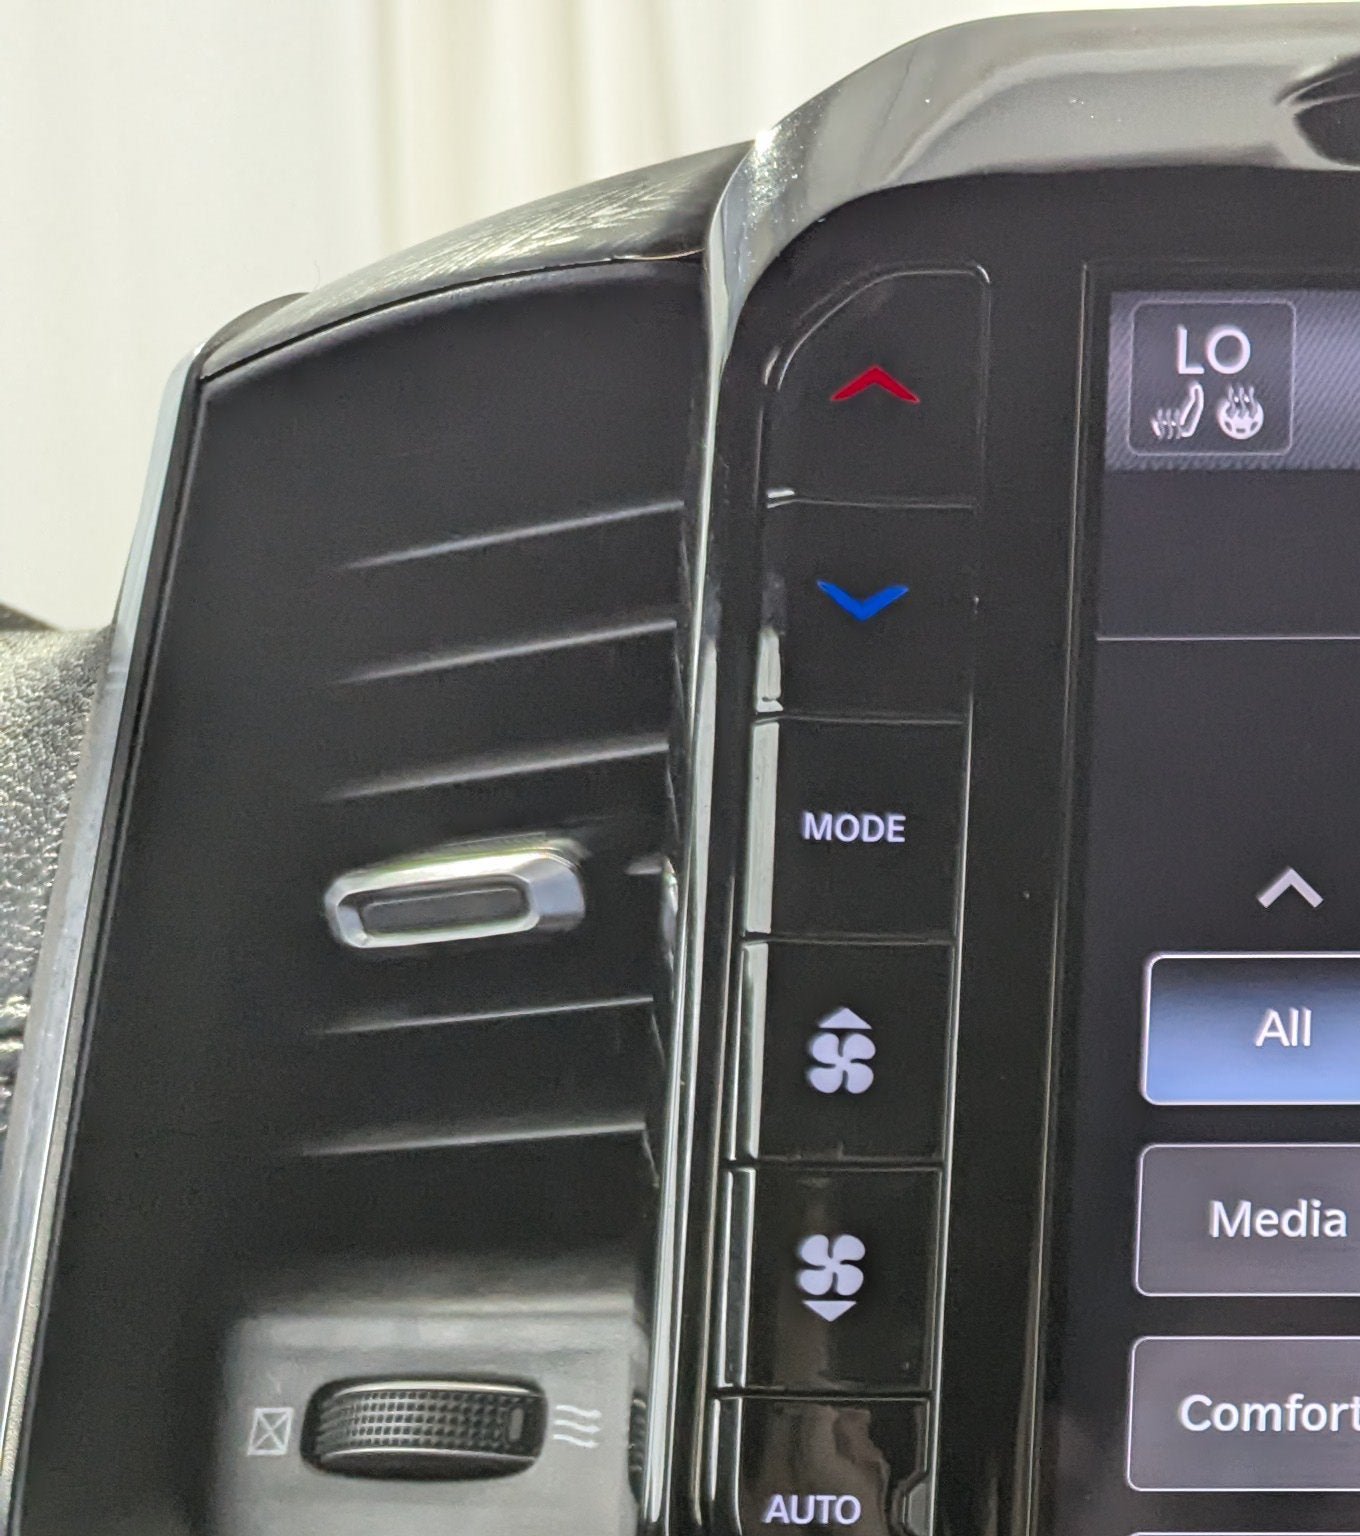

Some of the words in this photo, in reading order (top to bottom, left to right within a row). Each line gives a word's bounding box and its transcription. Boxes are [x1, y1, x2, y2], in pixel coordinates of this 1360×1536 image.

[1177, 326, 1251, 375] LO
[804, 812, 906, 843] MODE
[1255, 1008, 1312, 1047] All
[1210, 1199, 1347, 1238] Media
[764, 1494, 862, 1525] AUTO
